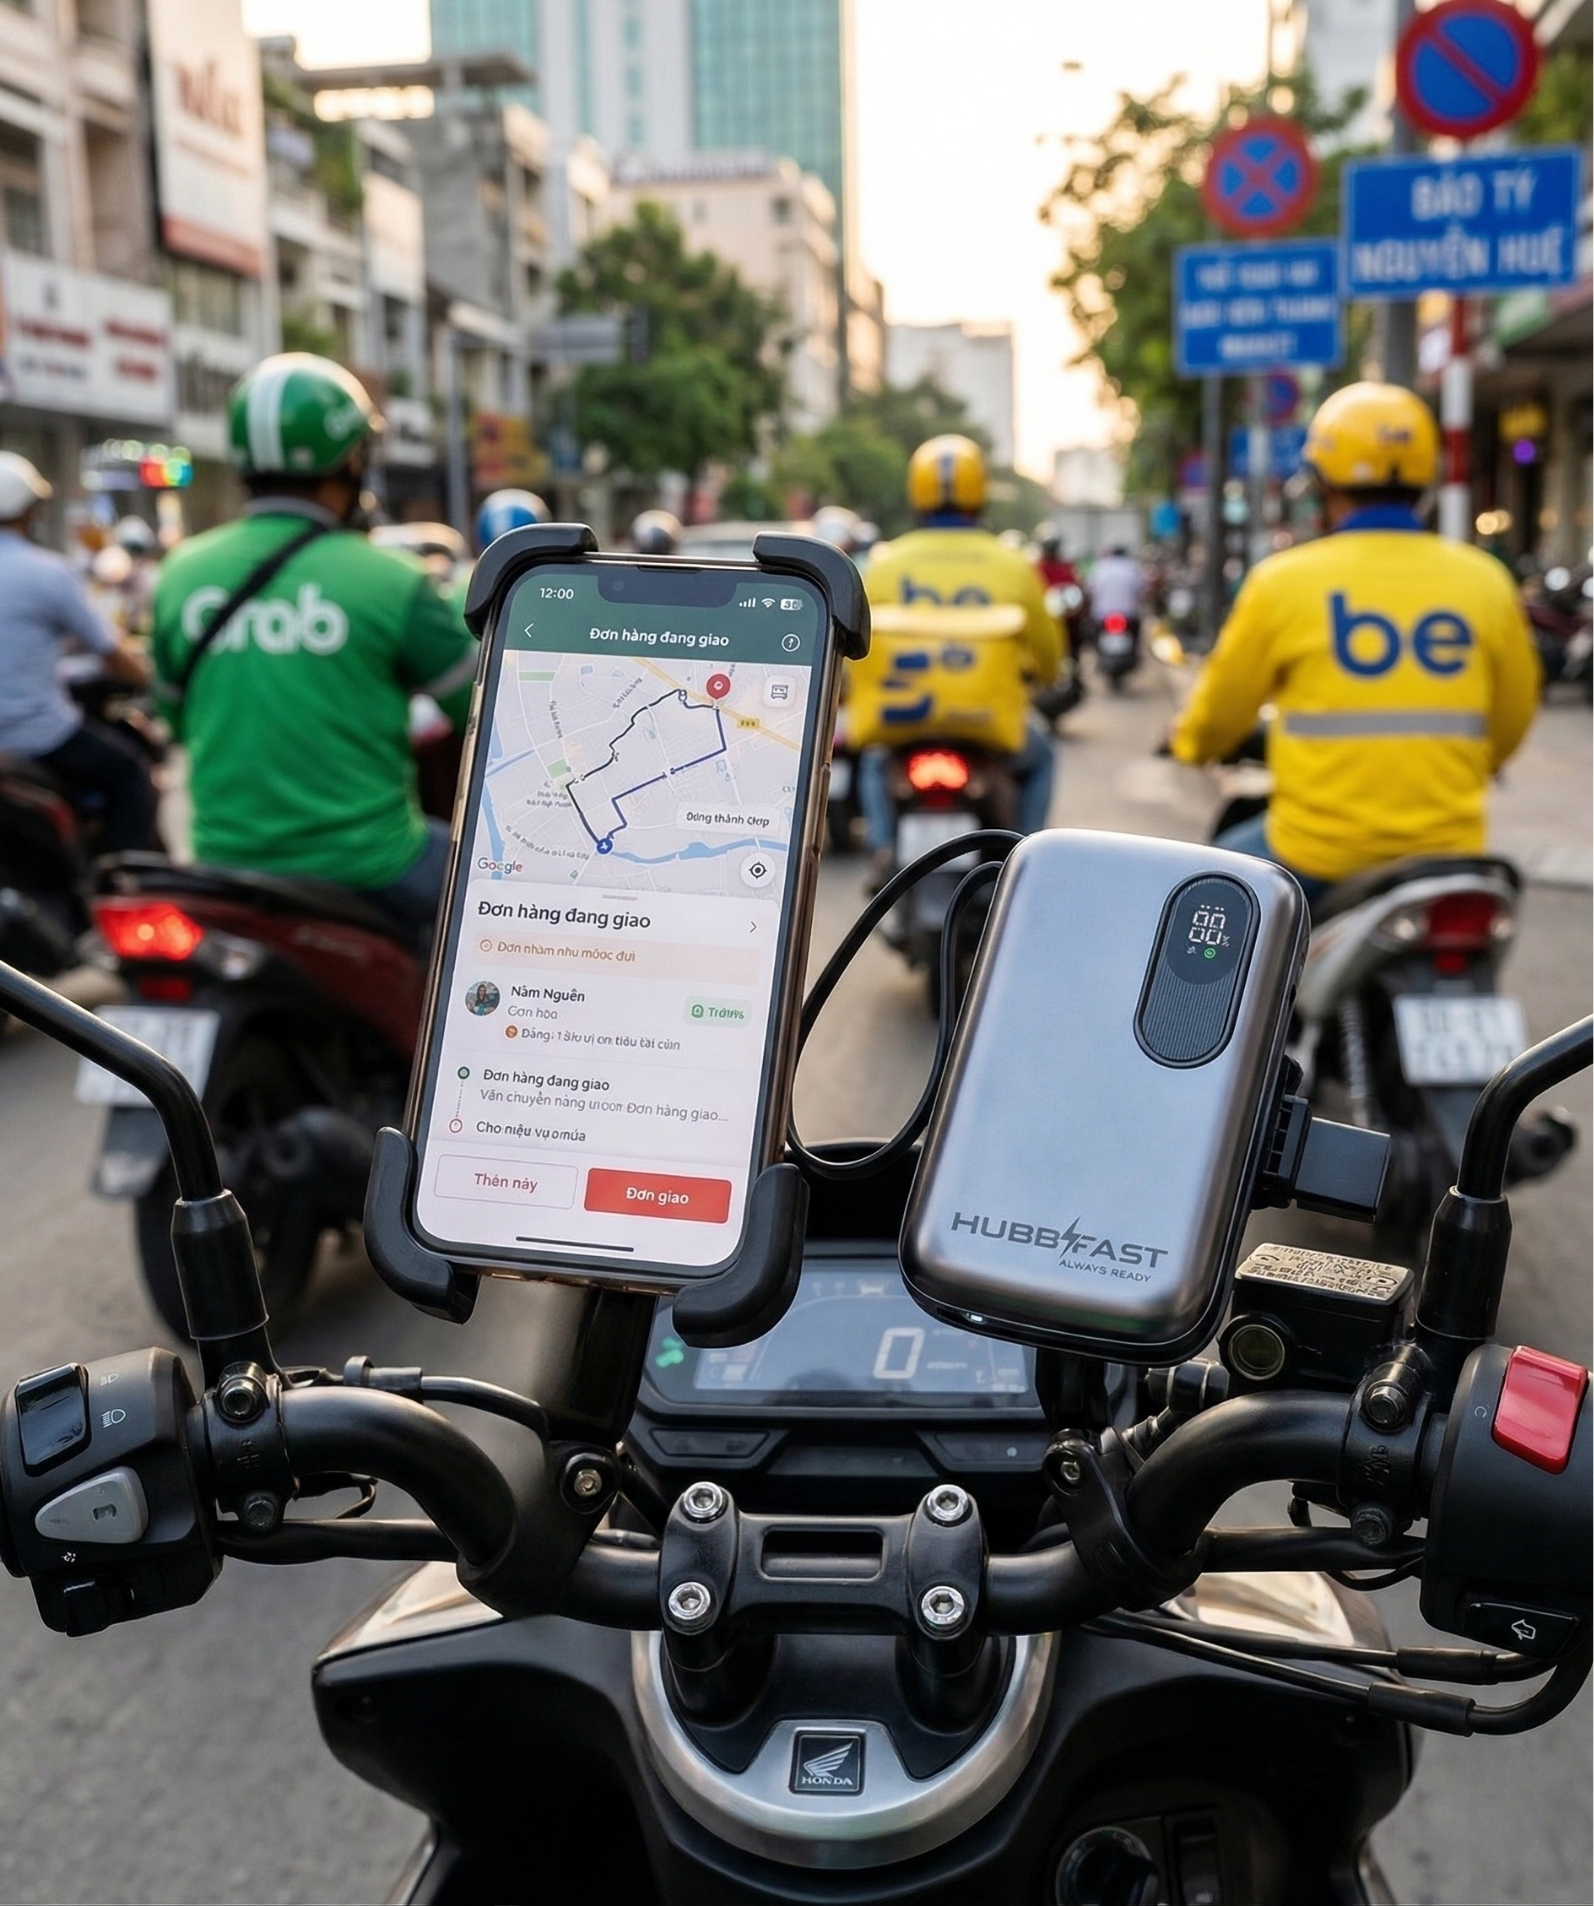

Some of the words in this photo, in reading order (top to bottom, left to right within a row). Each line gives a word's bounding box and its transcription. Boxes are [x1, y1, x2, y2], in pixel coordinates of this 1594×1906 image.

[539, 587, 574, 600] 12:00
[590, 628, 618, 641] Đơn
[622, 628, 657, 645] hàng
[660, 631, 696, 647] đang
[699, 633, 729, 647] giao
[1330, 592, 1472, 678] be
[478, 901, 513, 917] Đơn
[518, 904, 561, 924] hàng
[565, 908, 609, 929] đang
[613, 911, 651, 930] giao
[484, 1069, 509, 1082] Đơn
[513, 1070, 544, 1088] hàng
[547, 1074, 579, 1091] đang
[582, 1077, 610, 1092] giao
[626, 1102, 653, 1115] Đơn
[656, 1104, 688, 1122] hàng
[476, 1121, 502, 1134] Cho
[625, 1187, 655, 1201] Đơn
[658, 1191, 689, 1206] giao
[1058, 1258, 1107, 1275] ALWAYS
[1110, 1268, 1151, 1283] READY
[873, 1327, 925, 1379] 0
[801, 1776, 853, 1785] HONDA
